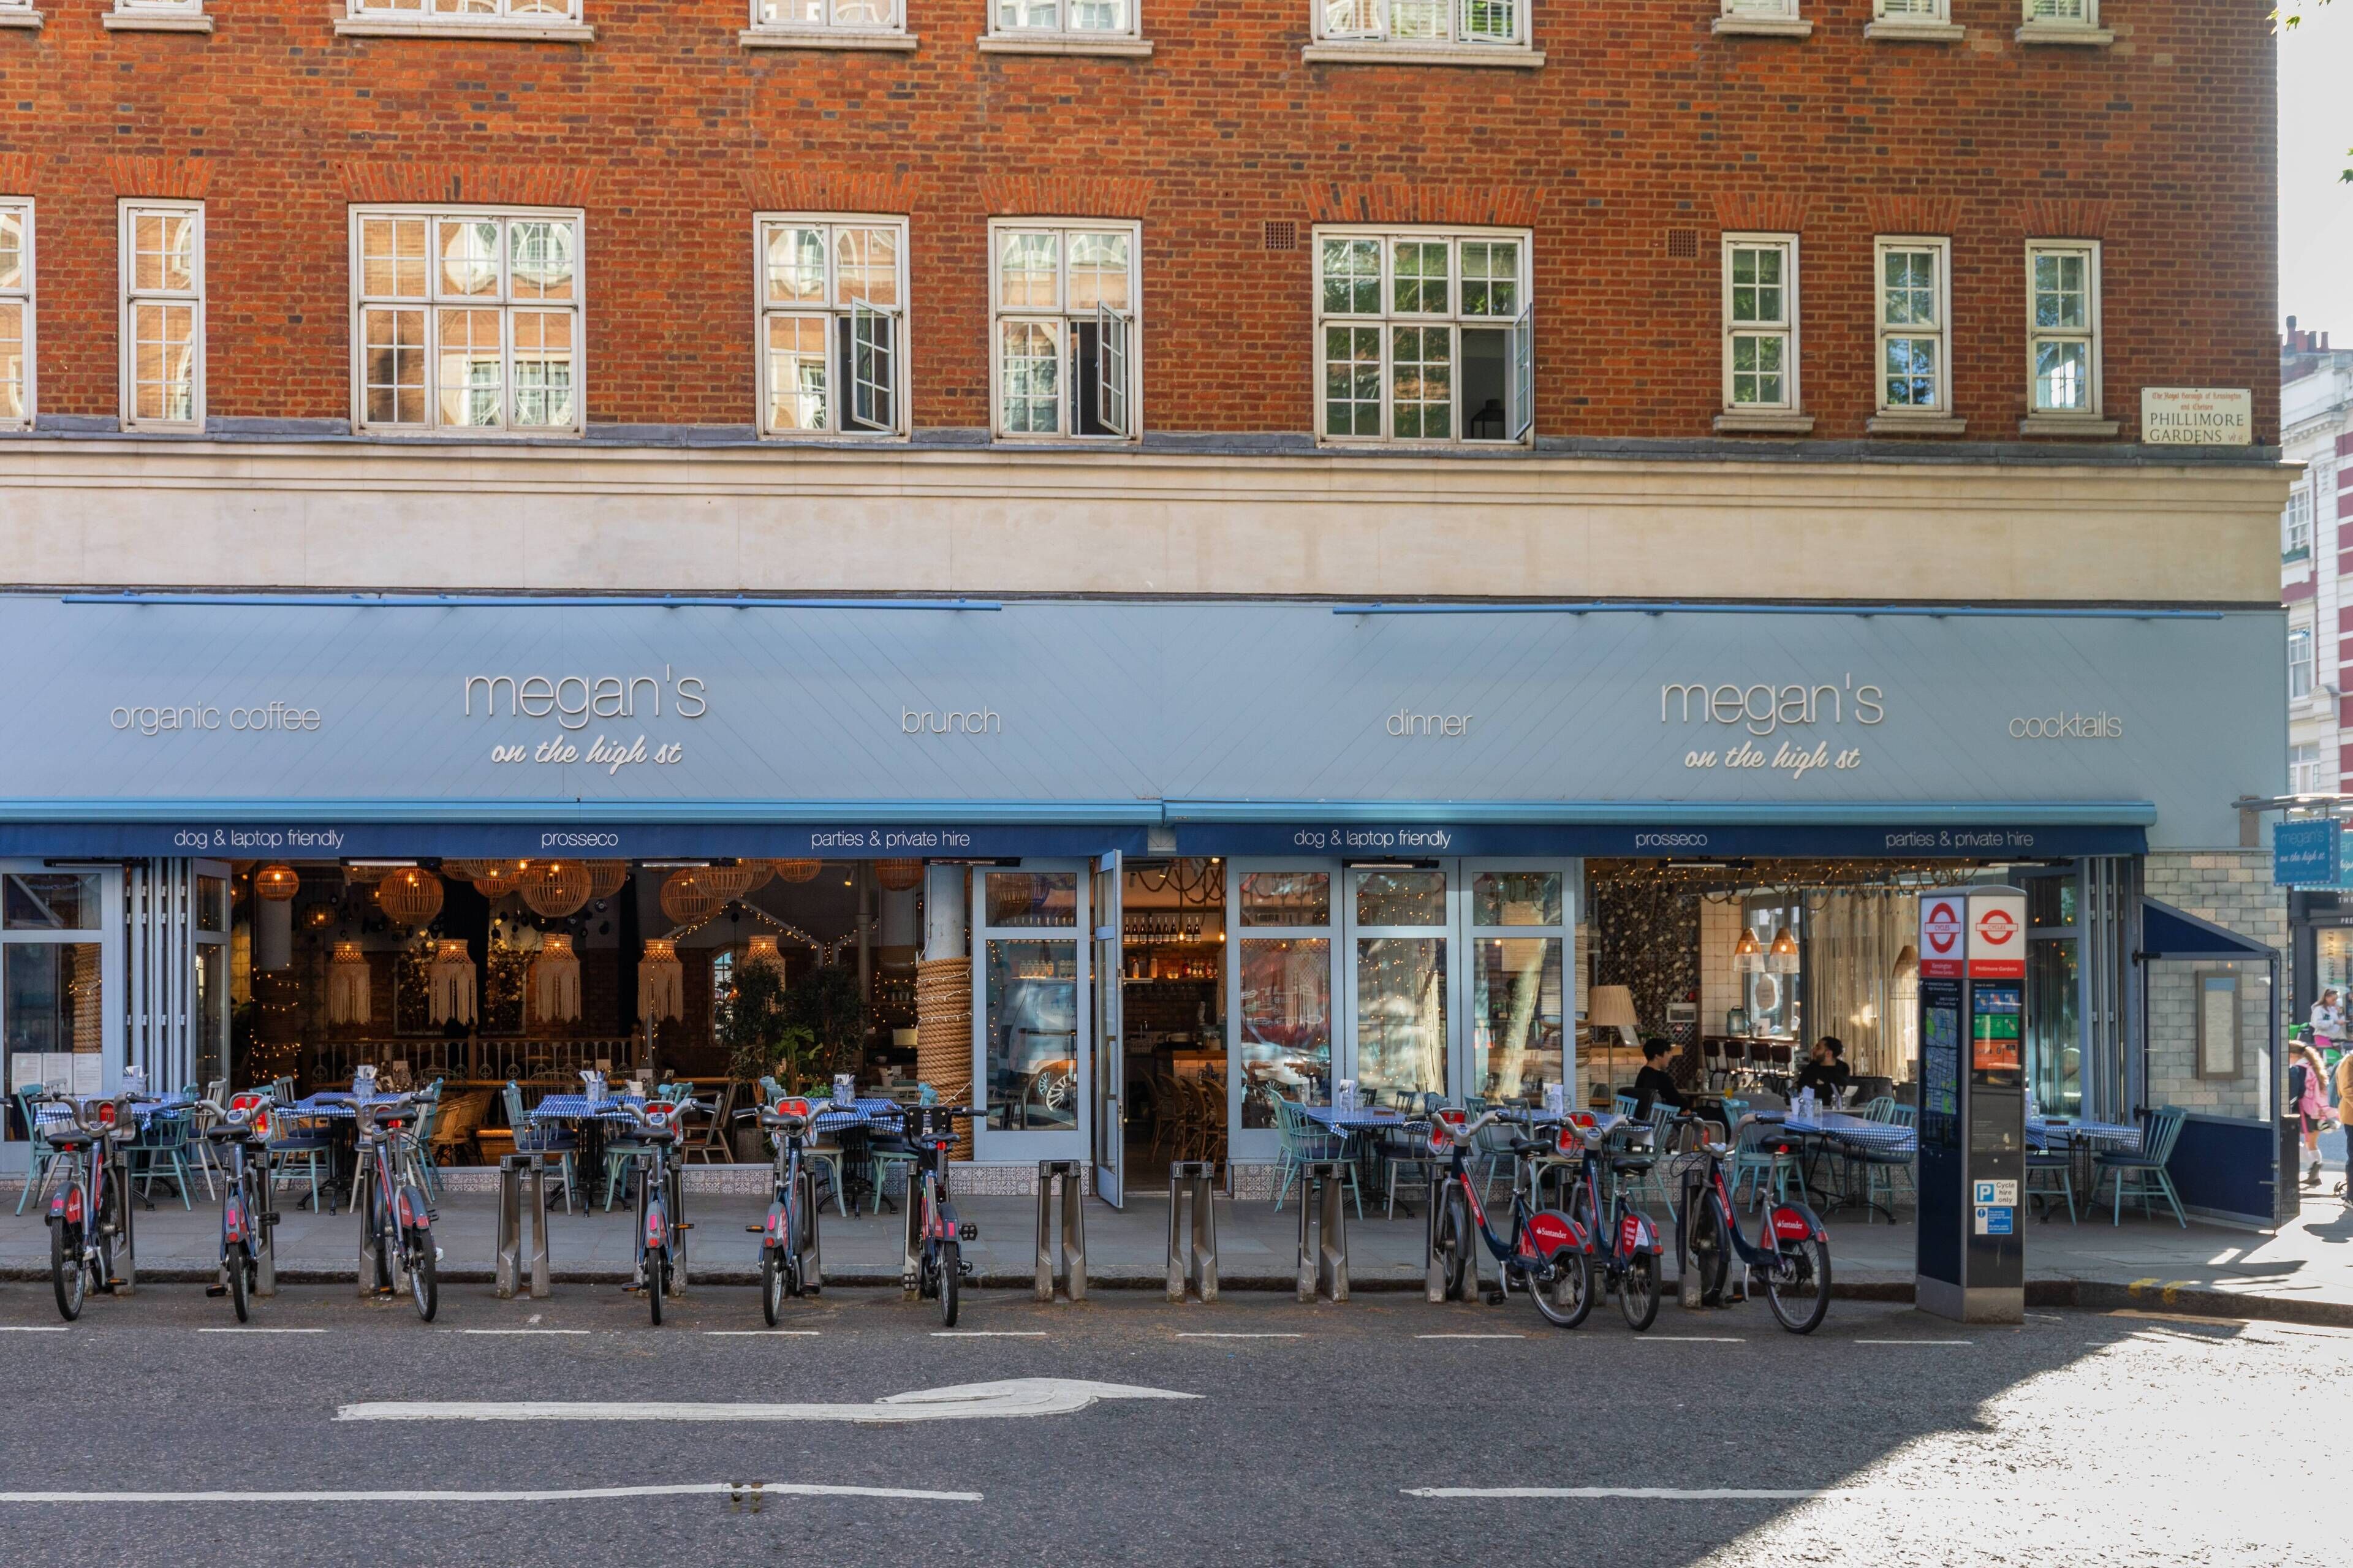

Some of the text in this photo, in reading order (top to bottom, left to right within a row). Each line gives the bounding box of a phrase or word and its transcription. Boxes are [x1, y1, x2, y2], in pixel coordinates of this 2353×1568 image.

[2164, 392, 2180, 401] Royal
[2181, 392, 2203, 401] Borough
[2213, 392, 2241, 401] Kensington
[2150, 412, 2244, 426] PHILLIMORE
[2150, 428, 2222, 442] GARDENS
[464, 663, 707, 729] megan's
[1661, 672, 1884, 735] megan's
[110, 700, 321, 736] organic coffee
[902, 705, 1001, 733] brunch
[1386, 707, 1473, 736] dinner
[2008, 710, 2123, 738] cocktails
[490, 733, 683, 776] on the high st
[1684, 740, 1861, 780] on the high st
[174, 828, 345, 850] dog & laptop friendly
[541, 832, 619, 850] prosseco
[811, 830, 971, 850] parties & private hire
[1294, 828, 1452, 850] dog & laptop friendly
[1635, 832, 1708, 849] prosseco
[1885, 830, 2034, 850] parties & private hire
[2281, 828, 2324, 847] megan's
[2302, 849, 2317, 865] high
[1979, 1185, 1991, 1201] P
[1541, 1227, 1567, 1239] Santander
[1781, 1220, 1803, 1230] Santander
